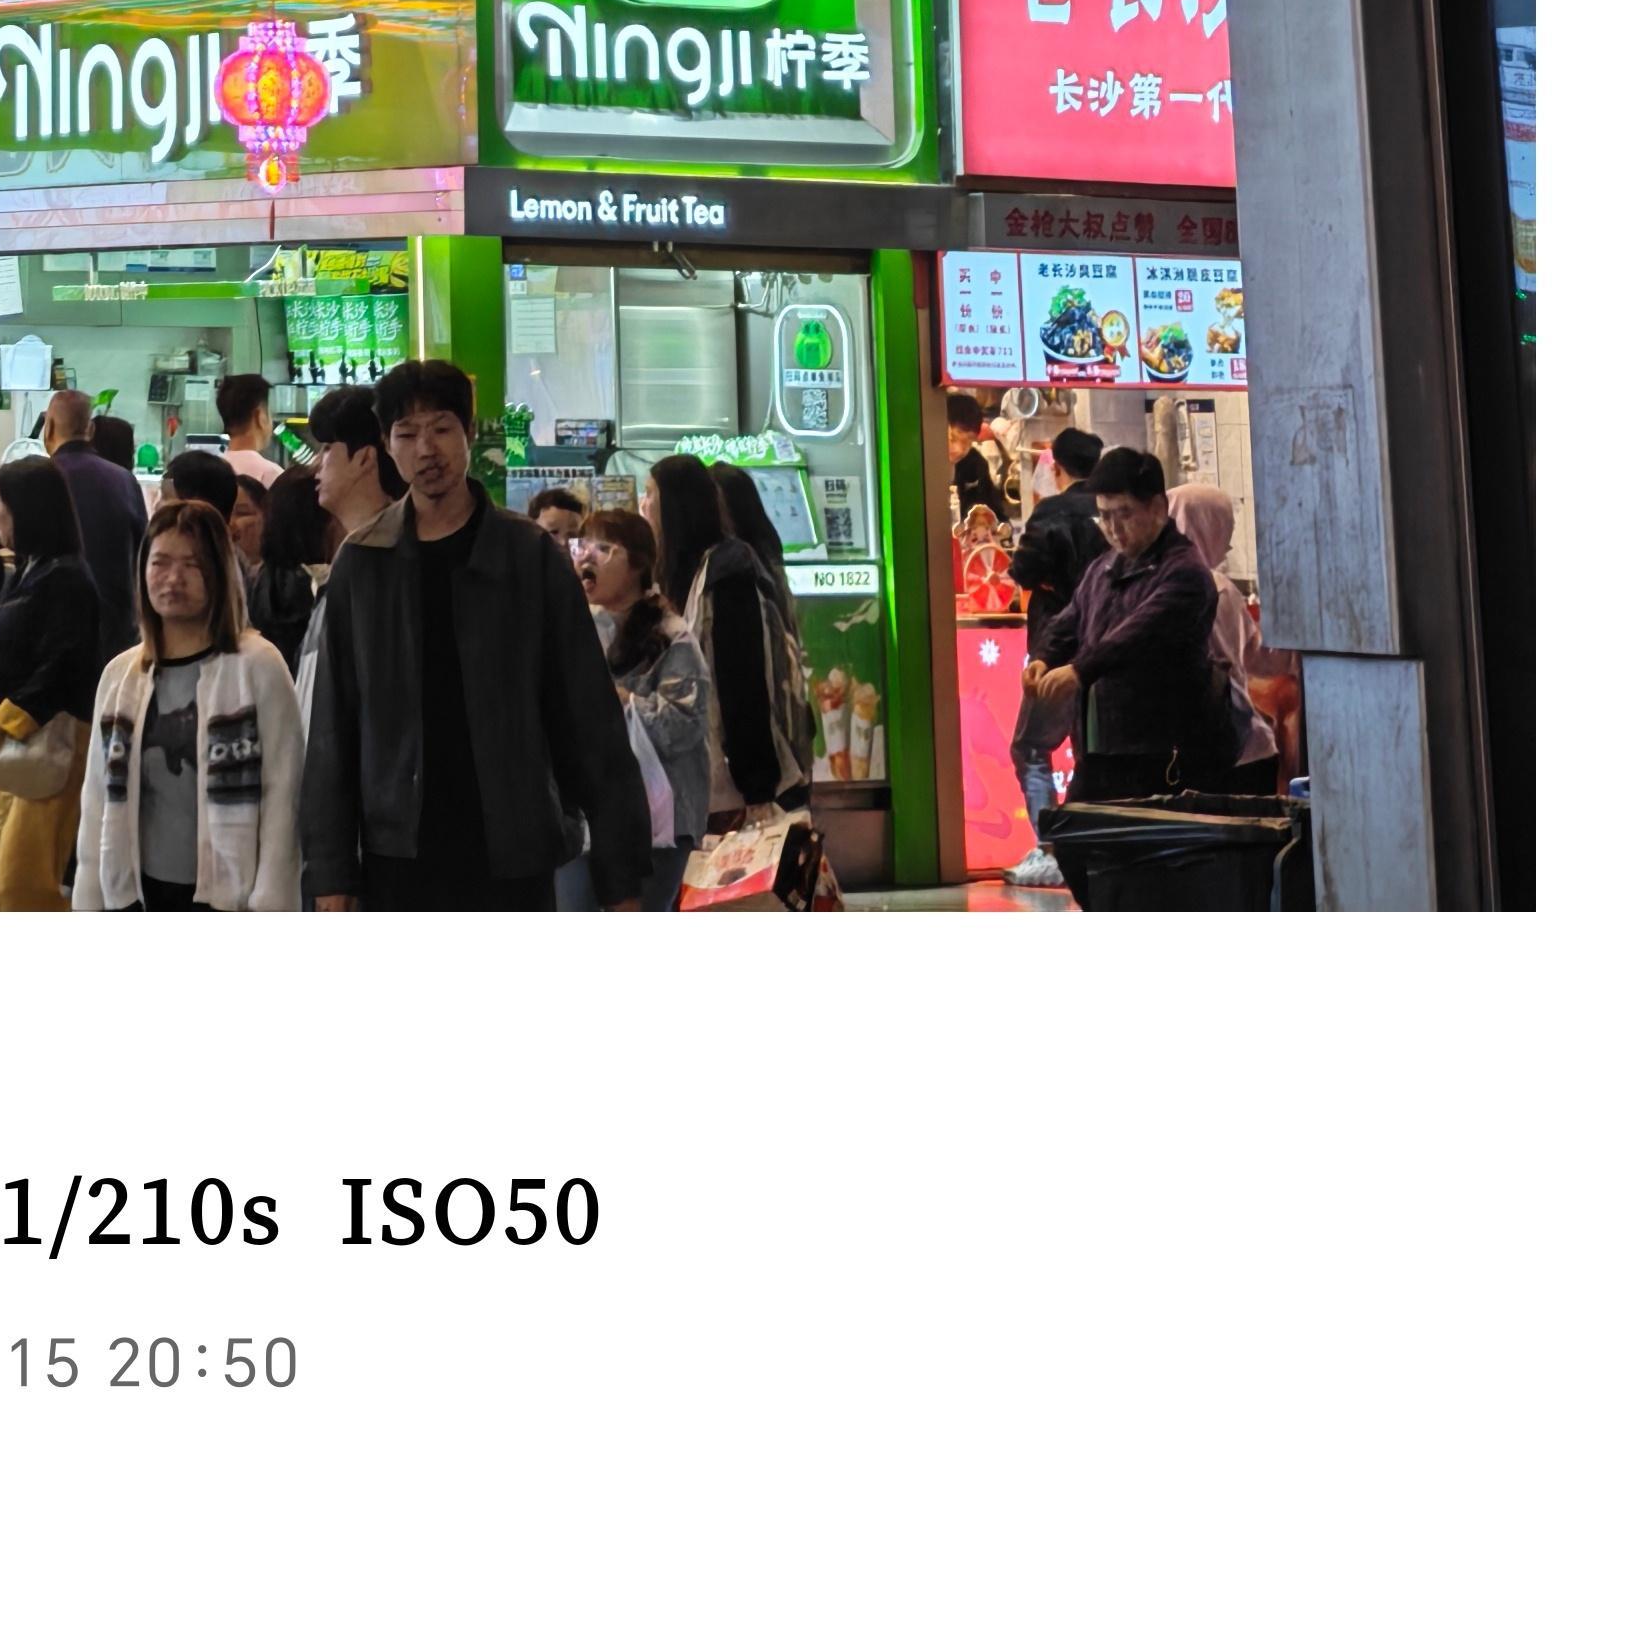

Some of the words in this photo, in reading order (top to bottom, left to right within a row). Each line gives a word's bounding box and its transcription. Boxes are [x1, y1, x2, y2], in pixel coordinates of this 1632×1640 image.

[764, 26, 872, 91] 柠季
[509, 189, 592, 222] Lemon
[597, 190, 617, 223] &
[621, 192, 680, 225] Fruit
[681, 195, 725, 227] Tea
[840, 571, 872, 586] 1822
